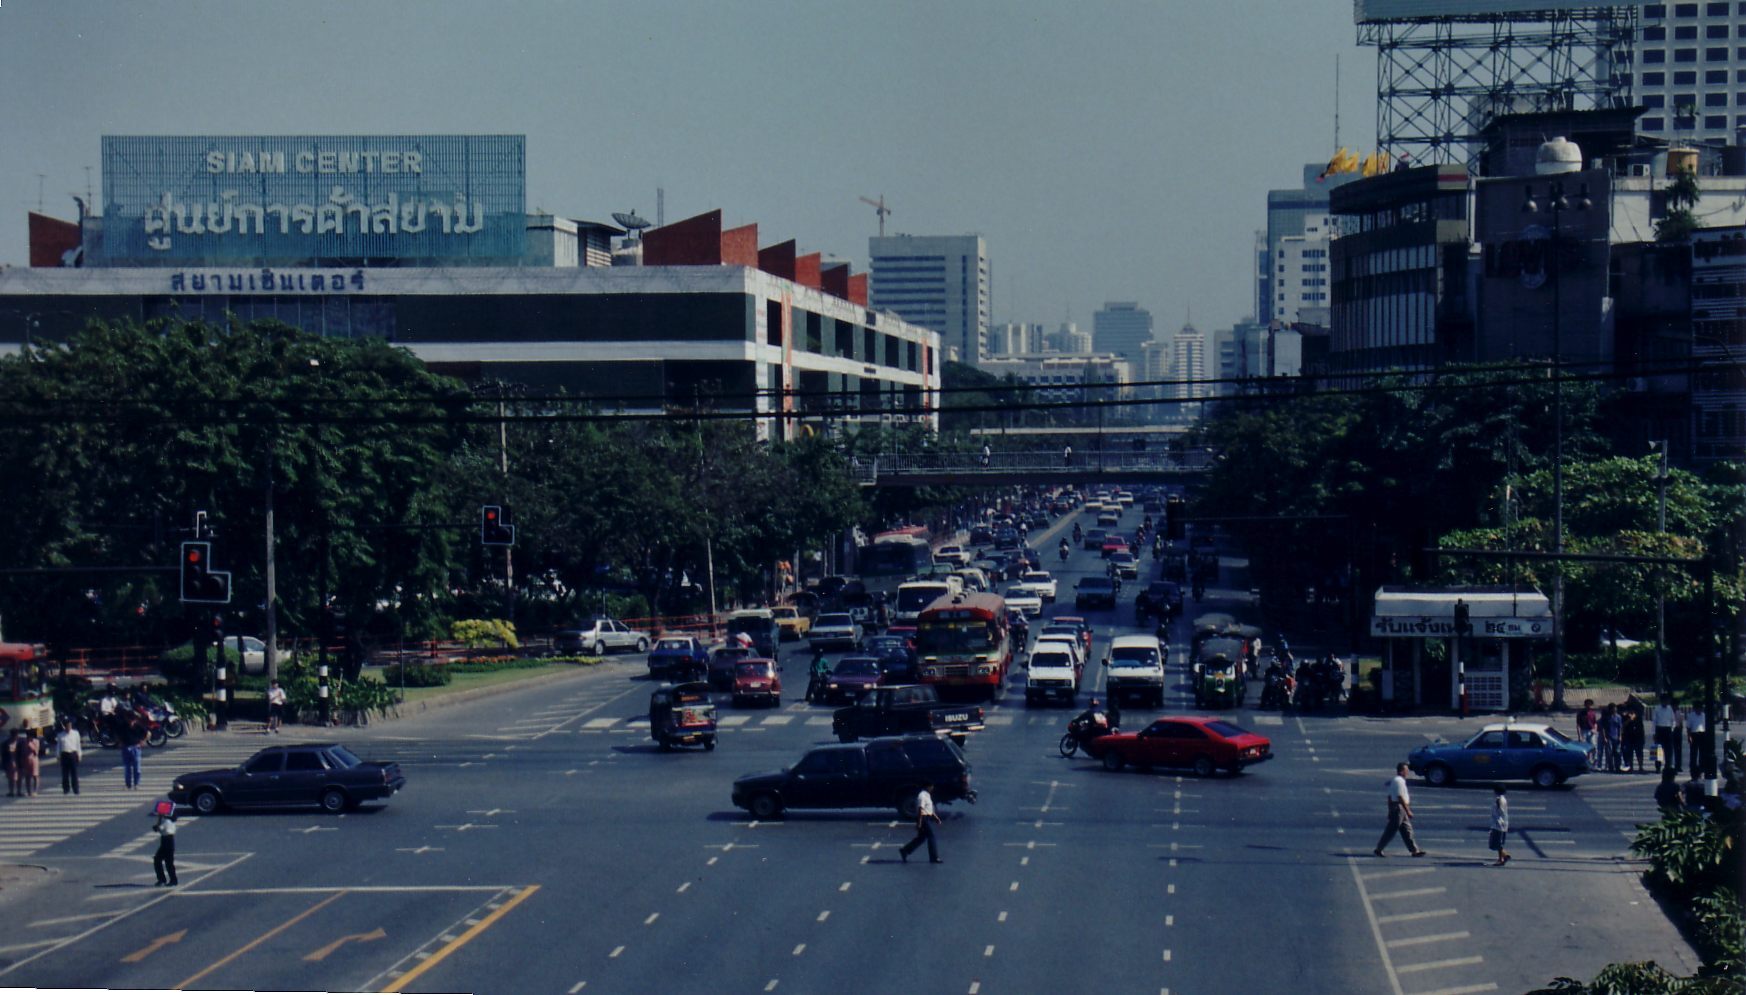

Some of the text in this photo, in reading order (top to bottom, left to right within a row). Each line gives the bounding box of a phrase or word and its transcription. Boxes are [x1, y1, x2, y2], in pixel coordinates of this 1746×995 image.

[206, 151, 423, 173] SIAM CENTER
[144, 185, 484, 250] ศูนย์การค้าสยาม
[944, 713, 969, 722] ISUZU
